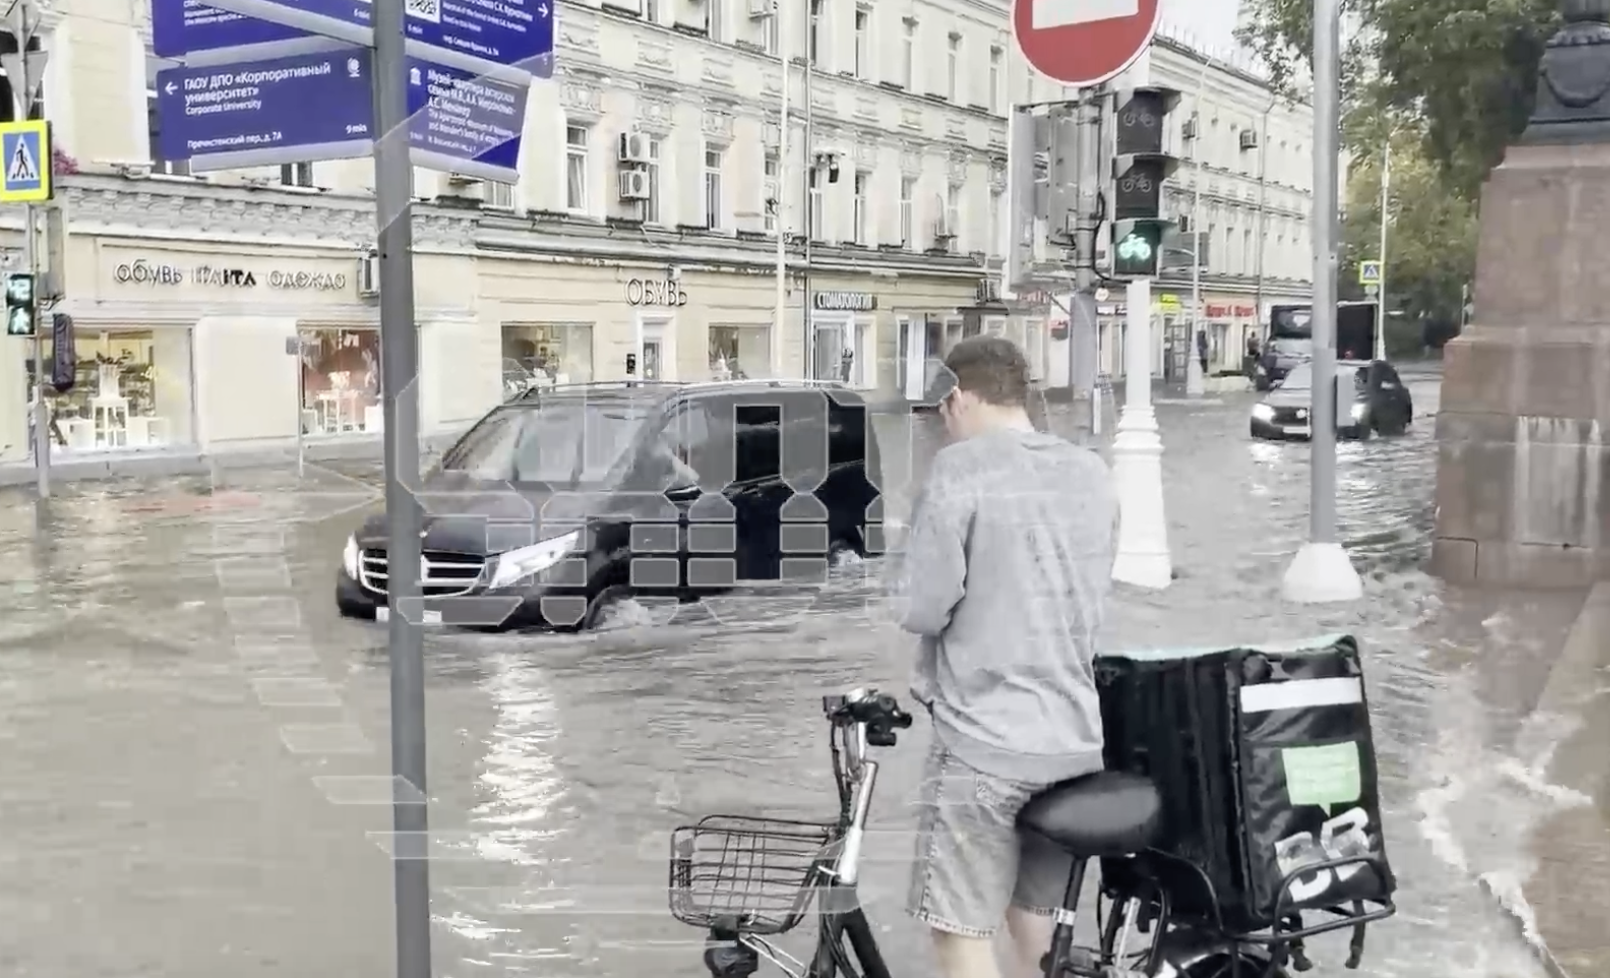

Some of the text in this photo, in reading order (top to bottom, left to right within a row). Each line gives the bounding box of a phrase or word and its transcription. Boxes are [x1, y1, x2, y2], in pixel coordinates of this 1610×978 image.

[184, 62, 331, 90] ГАОУ ДПО «Корпоративный
[184, 86, 259, 106] университет»
[185, 99, 262, 116] Corporate University
[625, 278, 687, 306] ОБУВЬ
